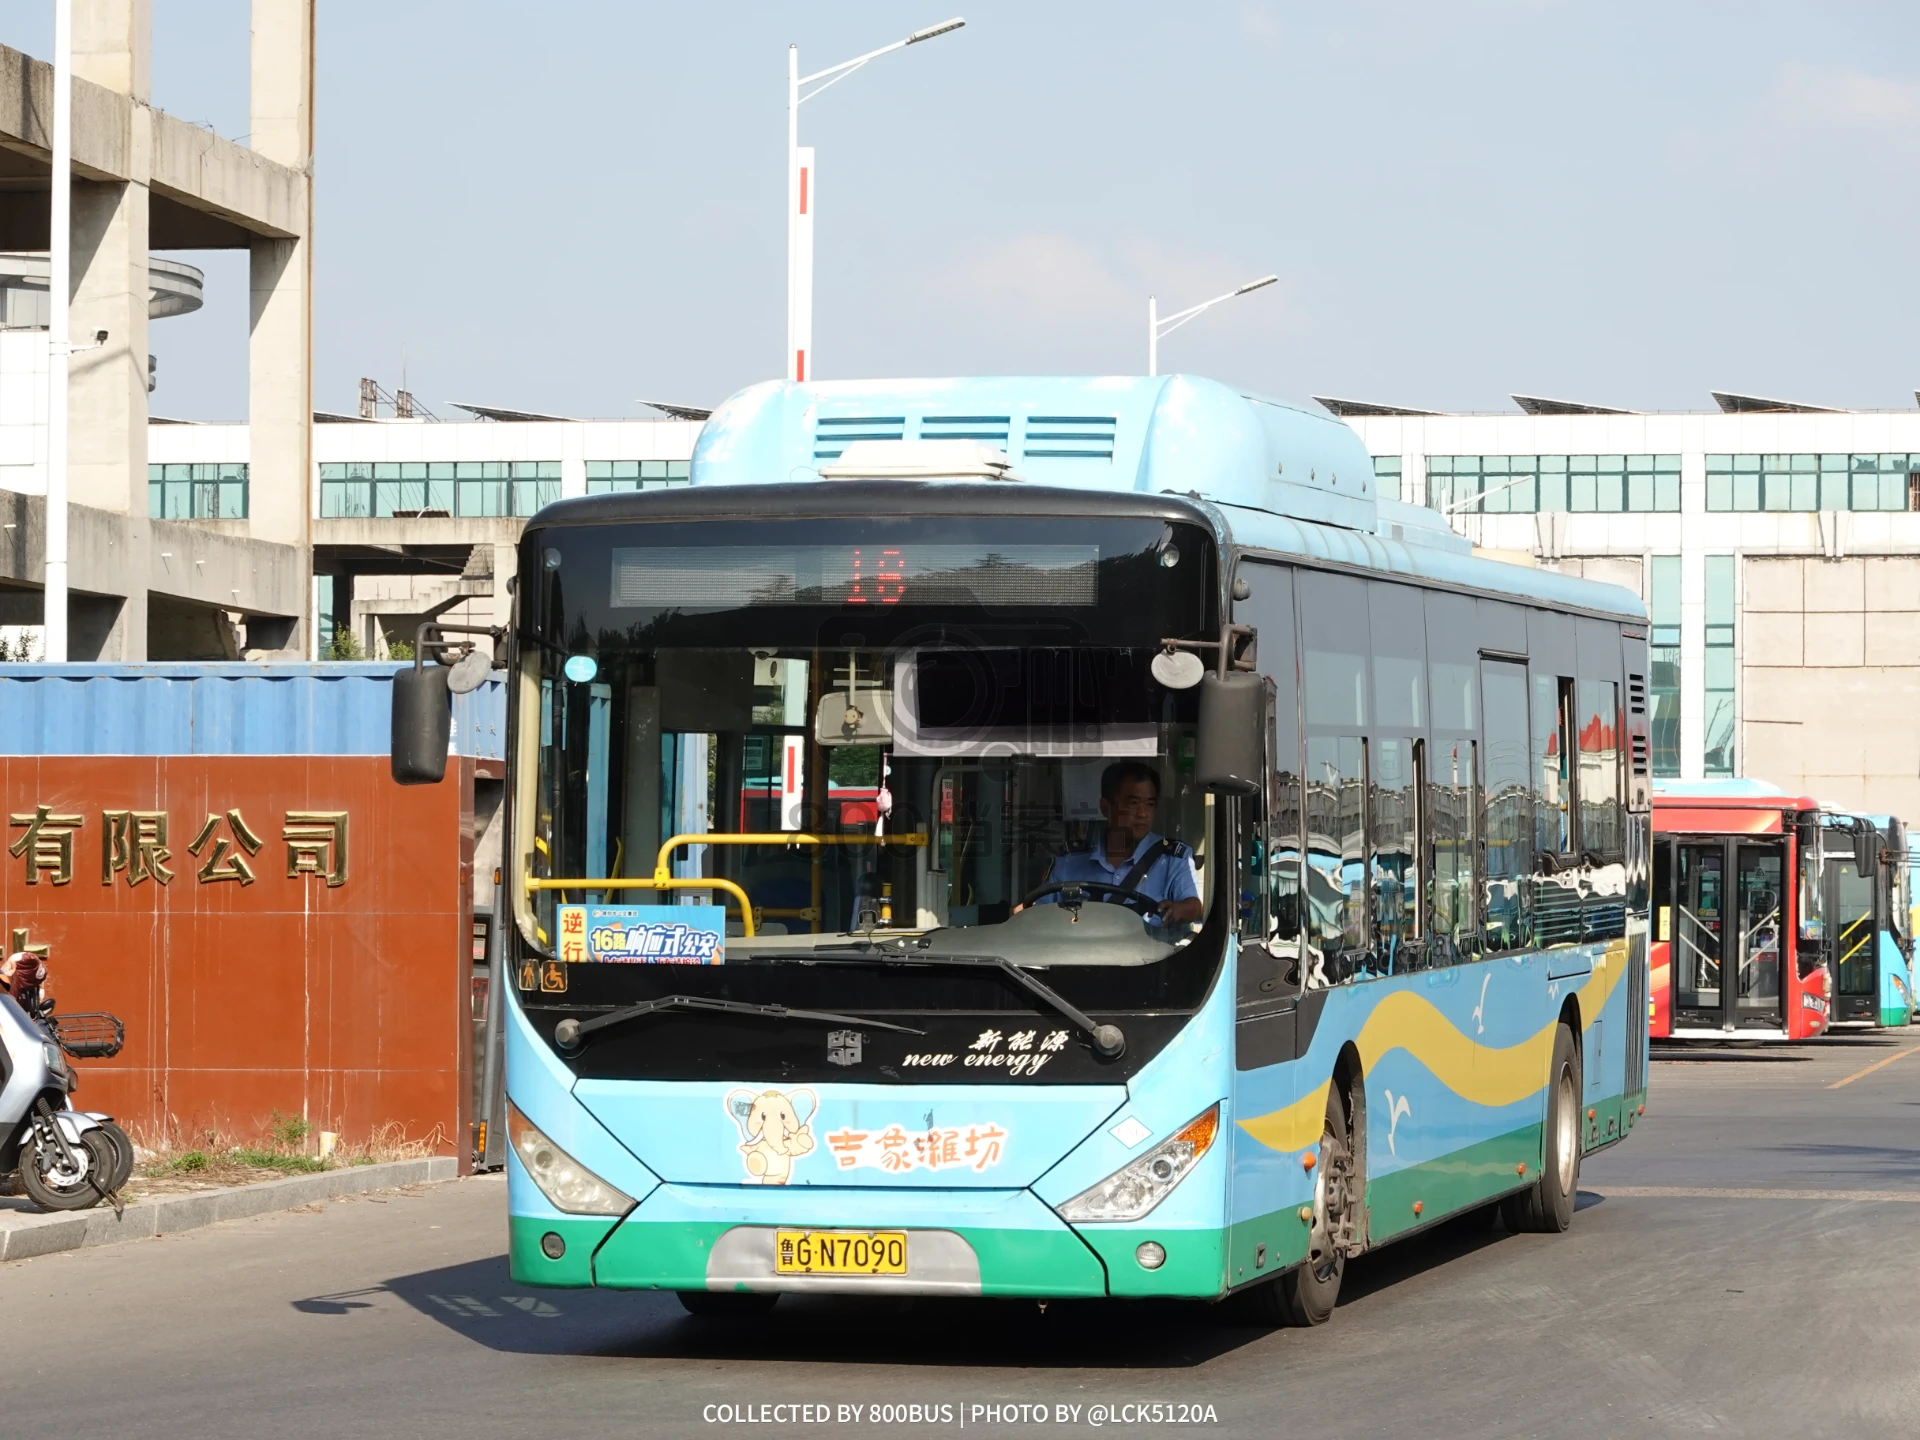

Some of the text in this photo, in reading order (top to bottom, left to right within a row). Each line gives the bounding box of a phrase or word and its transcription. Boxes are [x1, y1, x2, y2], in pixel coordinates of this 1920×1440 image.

[8, 804, 349, 887] 有限公司
[563, 912, 584, 962] 逆行
[592, 924, 719, 957] 16路响应式公交
[968, 1029, 1069, 1052] 新能源
[902, 1053, 1053, 1076] new energy
